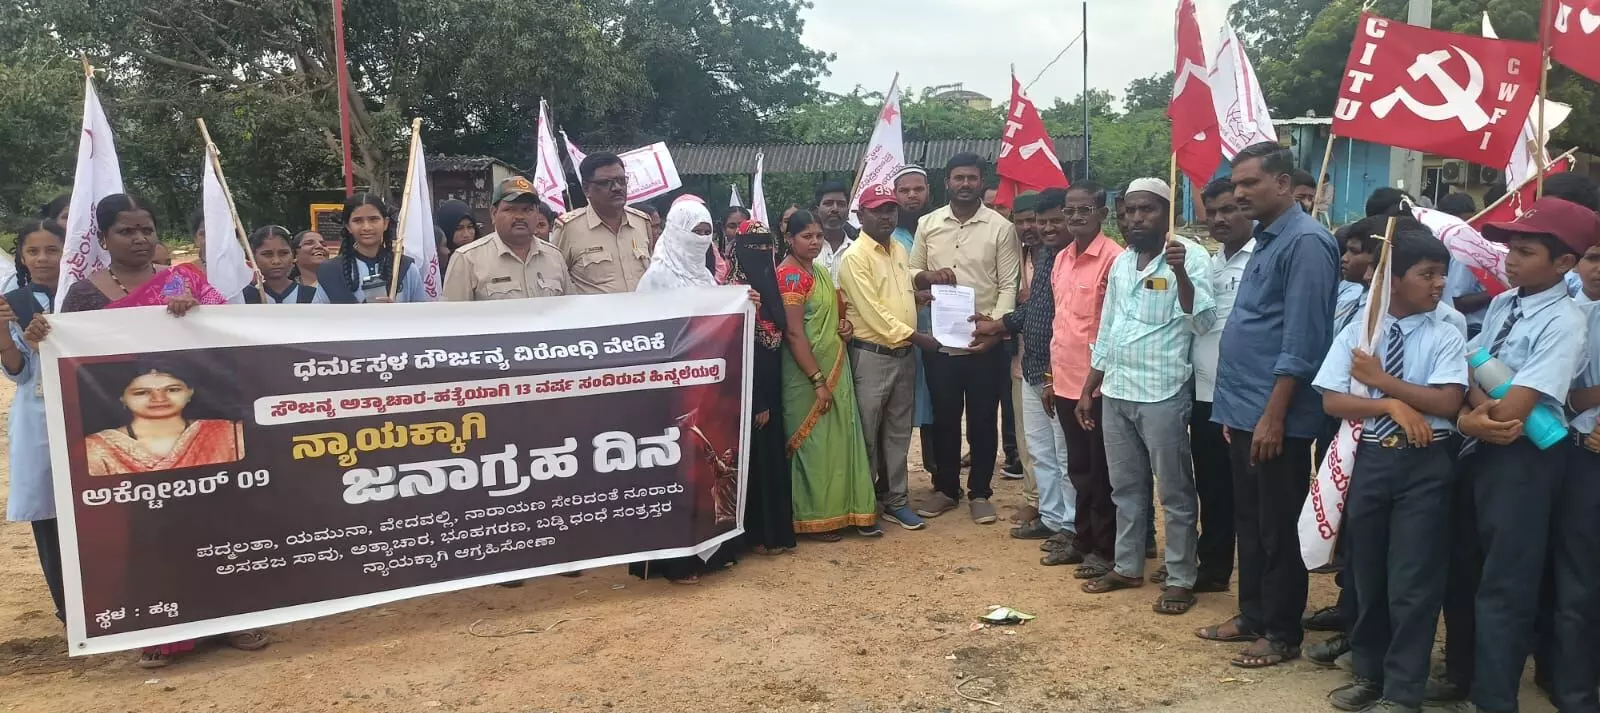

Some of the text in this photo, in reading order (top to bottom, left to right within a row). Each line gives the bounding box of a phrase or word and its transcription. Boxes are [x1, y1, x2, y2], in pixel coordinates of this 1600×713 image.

[1334, 17, 1389, 121] CITU
[1478, 56, 1521, 151] CWFI
[293, 332, 666, 382] ಧರ್ಮಸ್ಥಳ ದೌರ್ಜನ್ಯ ವಿರೋಧಿ ವೇದಿಕೆ
[270, 399, 337, 418] ಸೌಜನ್ಯ
[515, 384, 531, 396] 13
[535, 379, 572, 394] ವರ್ಷ
[578, 373, 645, 391] ಸಂದಿರುವ
[292, 411, 487, 468] ನ್ಯಾಯಕ್ಕಾಗಿ
[342, 426, 682, 505] ಜನಾಗ್ರಹ ದಿನ
[82, 469, 270, 509] ಅಕ್ಟೋಬರ್ 09
[196, 482, 685, 561] ಪದ್ಮಲತಾ, ಯಮುನಾ, ವೇದವಲ್ಲಿ, ನಾರಾಯಣ ಸೇರಿದಂತೆ ನೂರಾರು
[216, 556, 287, 576] ಅಸಹಜ
[293, 546, 344, 565] ಸಾವು,
[350, 530, 435, 557] ಅತ್ಯಾಚಾರ,
[440, 522, 531, 547] ಭೂಹಗರಣ,
[536, 513, 569, 531] ಬಡ್ಡಿ
[612, 500, 673, 521] ಸಂತ್ರಸ್ತರ
[362, 549, 449, 577] ನ್ಯಾಯಕ್ಕಾಗಿ
[95, 607, 126, 630] ಸ್ಥಳ
[149, 601, 180, 618] ಹಟ್ಟಿ
